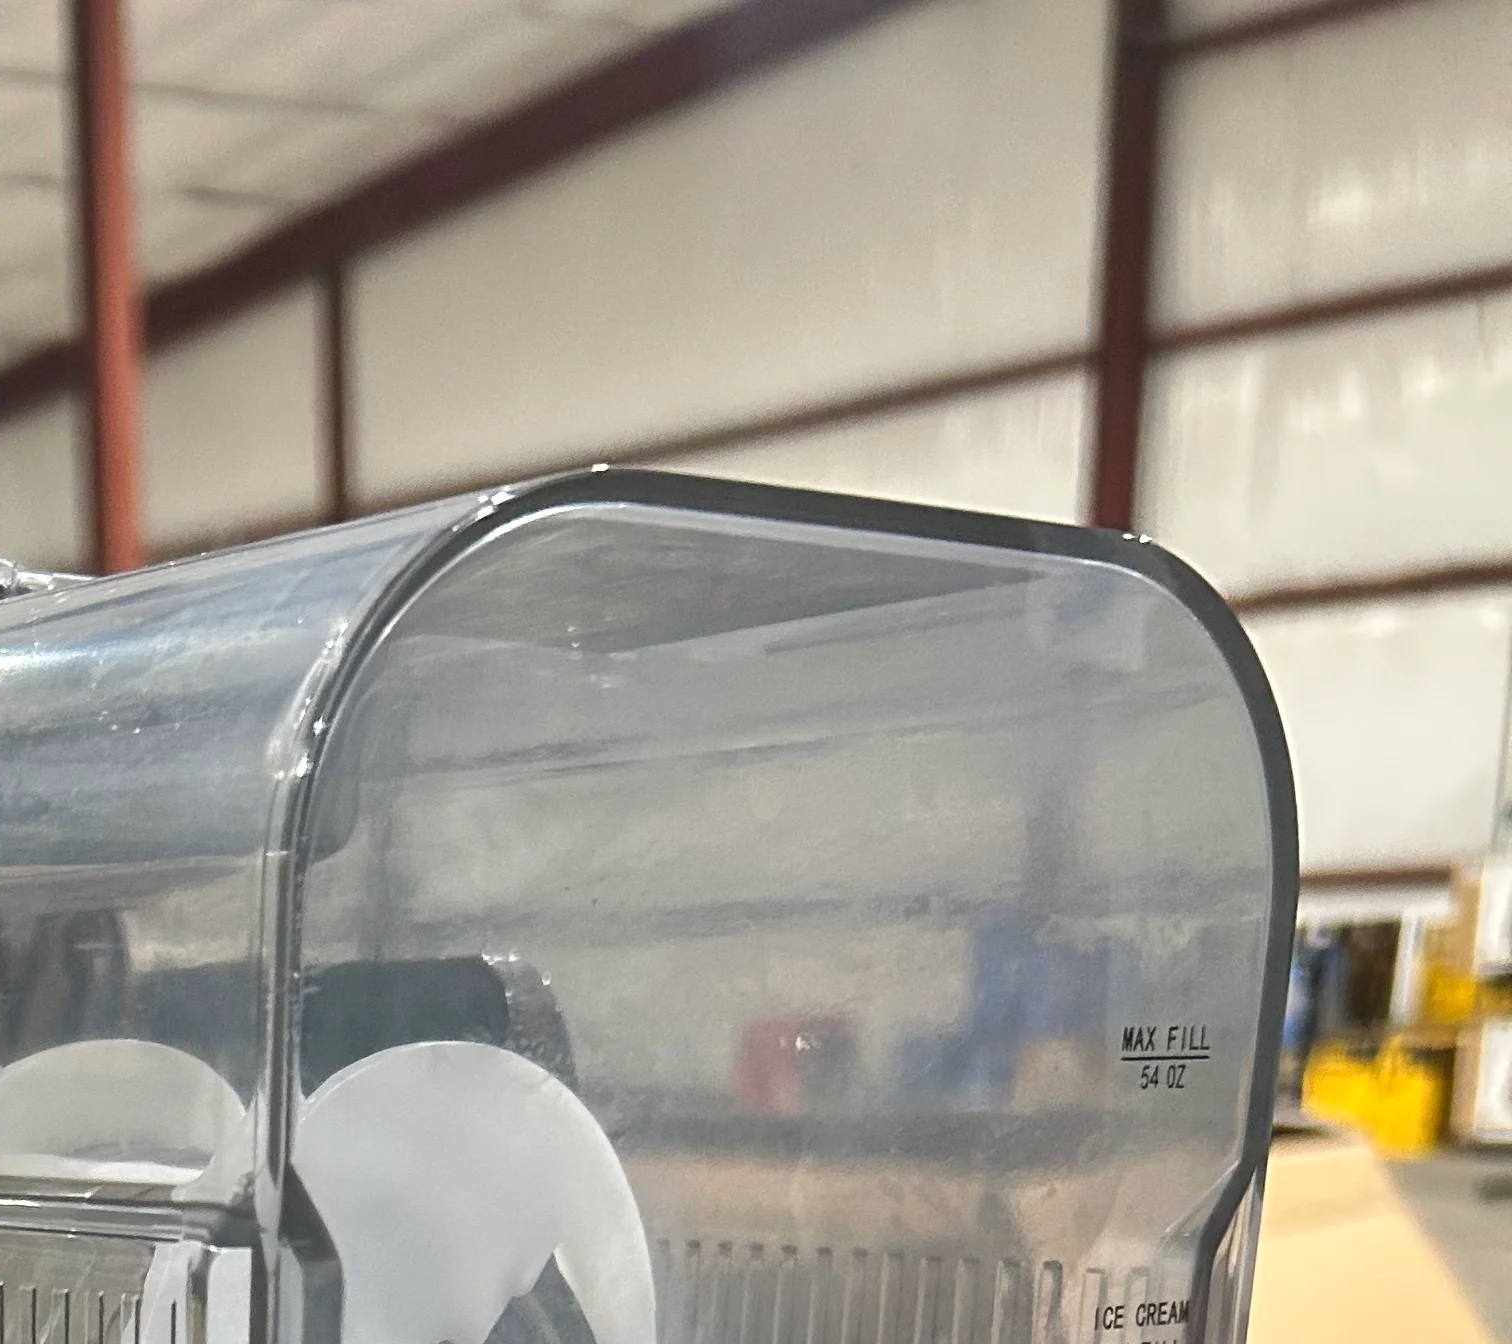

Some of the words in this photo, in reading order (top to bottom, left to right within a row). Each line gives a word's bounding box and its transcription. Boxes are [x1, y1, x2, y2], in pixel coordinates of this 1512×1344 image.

[1121, 1026, 1157, 1052] MAX
[1167, 1025, 1210, 1051] FILL
[1140, 1065, 1159, 1090] 54
[1167, 1064, 1186, 1089] OZ
[1094, 1305, 1125, 1331] ICE
[1135, 1300, 1190, 1327] CREAM
